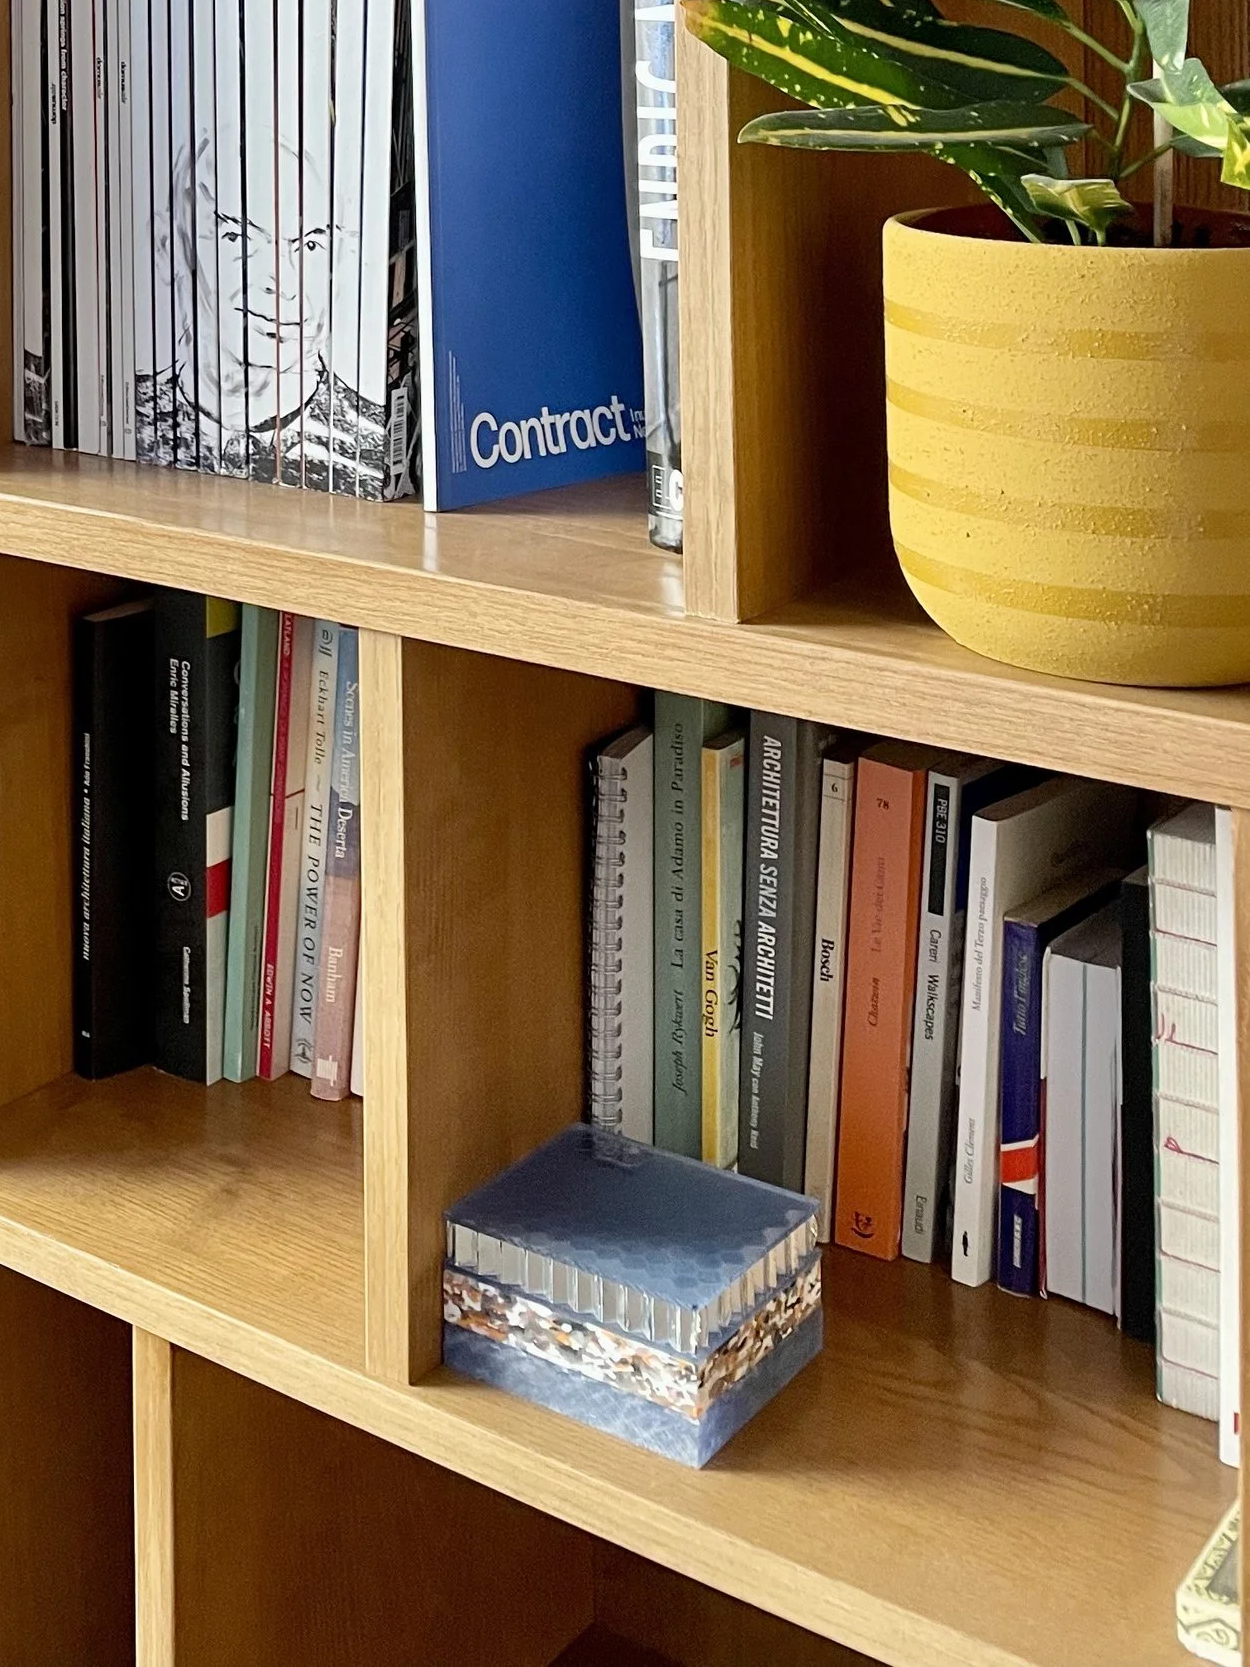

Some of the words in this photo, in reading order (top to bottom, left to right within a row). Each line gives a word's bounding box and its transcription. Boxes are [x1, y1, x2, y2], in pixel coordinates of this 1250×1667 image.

[470, 395, 631, 469] Contract
[169, 658, 179, 688] Enric
[169, 690, 178, 734] Miralles
[180, 660, 191, 742] Conversations
[315, 670, 330, 726] Eckhart
[343, 679, 358, 731] Scenes
[180, 744, 190, 766] and
[313, 730, 328, 767] Tolle
[342, 732, 357, 746] in
[669, 723, 684, 792] Paradiso
[180, 768, 190, 821] Allusions
[338, 748, 356, 805] America
[830, 782, 839, 793] 6
[670, 800, 684, 815] in
[759, 734, 782, 861] ARCHITETTURA
[876, 797, 890, 812] 78
[936, 797, 948, 822] PBE
[81, 797, 91, 845] italiana
[309, 803, 324, 848] THE
[334, 806, 354, 859] Deserta
[934, 822, 947, 845] 310
[670, 821, 684, 880] Adamo
[81, 847, 90, 920] architettura
[303, 854, 321, 931] POWER
[670, 886, 684, 902] di
[758, 862, 778, 919] SENZA
[978, 876, 989, 922] paesaggio
[82, 922, 90, 961] nuova
[673, 909, 684, 942] casa
[870, 937, 882, 953] Le
[974, 922, 985, 948] Terzo
[182, 946, 191, 985] Catherine
[302, 936, 317, 967] OF
[670, 949, 684, 969] La
[705, 949, 719, 980] Van
[754, 920, 777, 1021] ARCHITETTI
[819, 937, 835, 983] Bosch
[973, 950, 983, 965] del
[265, 963, 275, 995] EDWIN
[325, 947, 344, 1004] Banham
[971, 966, 983, 1012] Manifesto
[298, 974, 315, 1026] NOW
[671, 989, 687, 1046] Rykwert
[702, 983, 719, 1038] Gogh
[924, 974, 940, 1041] Walkscapes
[261, 1009, 272, 1049] ABBOTT
[752, 1031, 764, 1054] John
[671, 1050, 687, 1096] Joseph
[750, 1055, 763, 1079] May
[751, 1078, 760, 1094] con
[749, 1095, 760, 1129] Anthony
[963, 1158, 974, 1184] Gilles
[914, 1194, 928, 1235] Einaudi
